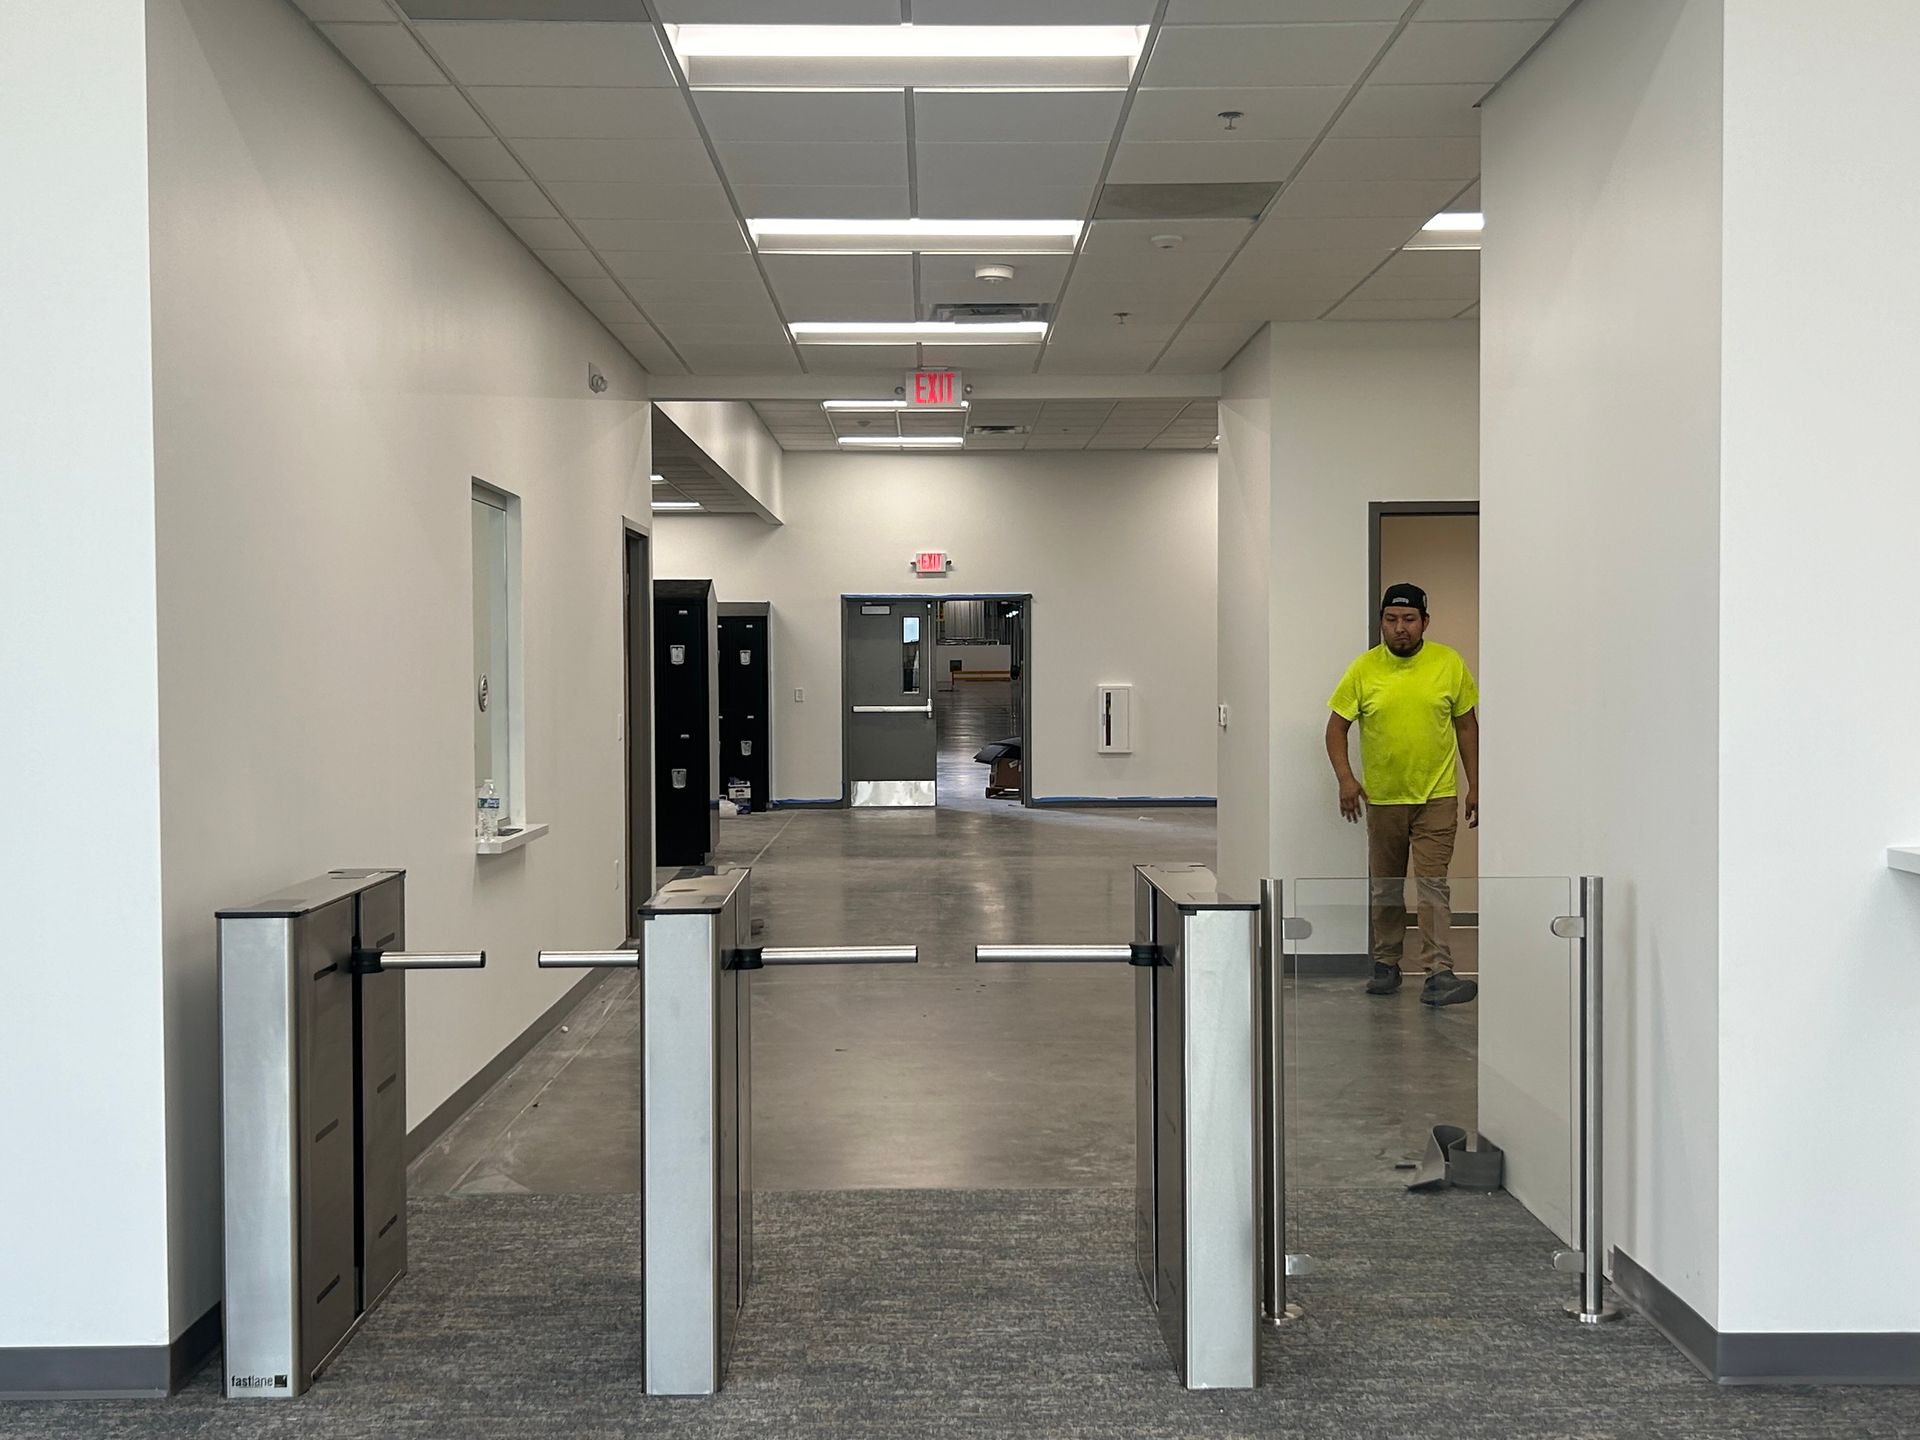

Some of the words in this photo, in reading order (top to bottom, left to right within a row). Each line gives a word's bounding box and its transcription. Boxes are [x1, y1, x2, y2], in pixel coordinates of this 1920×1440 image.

[915, 372, 954, 404] EXIT
[921, 553, 941, 570] EXIT
[231, 1375, 273, 1388] fastlane
